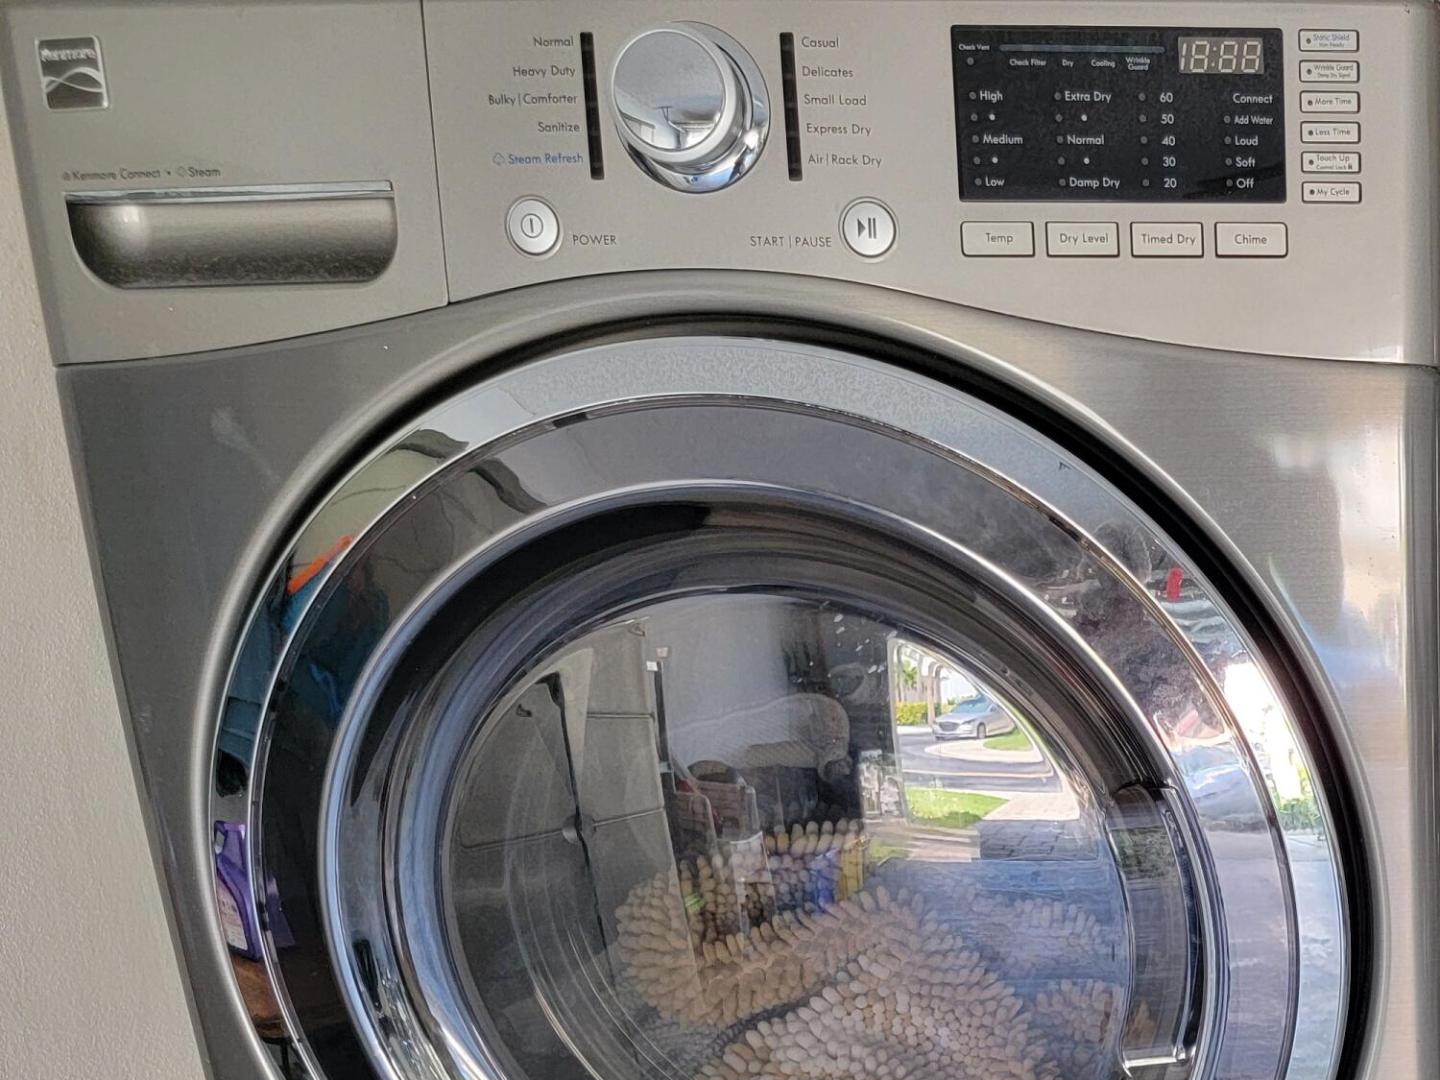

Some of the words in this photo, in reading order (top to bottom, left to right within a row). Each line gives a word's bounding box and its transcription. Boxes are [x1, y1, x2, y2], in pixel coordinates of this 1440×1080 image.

[533, 36, 575, 47] Normal
[801, 36, 839, 48] Casual
[1009, 58, 1029, 67] Check
[1030, 58, 1047, 67] Filter
[1062, 59, 1075, 69] Dry
[1090, 59, 1116, 69] Cooling
[512, 66, 548, 79] Heavy
[551, 65, 576, 78] Duty
[801, 66, 854, 78] Delicates
[803, 94, 835, 105] Small
[839, 95, 867, 106] Load
[979, 90, 1003, 104] High
[1064, 91, 1090, 102] Extra
[1093, 91, 1112, 104] Dry
[1159, 92, 1174, 104] 60
[1232, 93, 1273, 104] Connect
[1315, 97, 1333, 105] More
[1335, 97, 1352, 105] Time
[1160, 113, 1175, 126] 50
[1233, 115, 1250, 126] Add
[1250, 116, 1274, 126] Water
[537, 121, 580, 133] Sanitize
[806, 123, 848, 136] Express
[851, 124, 871, 137] Dry
[1315, 128, 1330, 136] Less
[1332, 128, 1351, 136] Time
[982, 133, 1024, 146] Medium
[1066, 134, 1105, 146] Normal
[1161, 135, 1176, 147] 40
[1234, 135, 1259, 147] Loud
[508, 154, 542, 165] Steam
[544, 153, 584, 164] Refresh
[862, 156, 882, 168] Dry
[1162, 156, 1176, 168] 30
[1235, 156, 1256, 168] Soft
[1316, 154, 1337, 162] Touch
[1338, 154, 1350, 164] Up
[187, 166, 221, 178] Steam
[984, 176, 1005, 188] Low
[1069, 176, 1100, 189] Damp
[1102, 177, 1121, 190] Dry
[1163, 177, 1177, 189] 20
[1235, 177, 1255, 189] Off
[1316, 188, 1328, 197] My
[1330, 187, 1350, 197] Cycle
[572, 234, 617, 246] POWER
[750, 235, 784, 248] START
[795, 236, 832, 248] PAUSE
[985, 232, 1014, 245] Temp
[1059, 233, 1078, 246] Dry
[1082, 233, 1109, 244] Level
[1140, 233, 1175, 245] Timed
[1177, 234, 1196, 246] Dry
[1233, 234, 1268, 245] Chime
